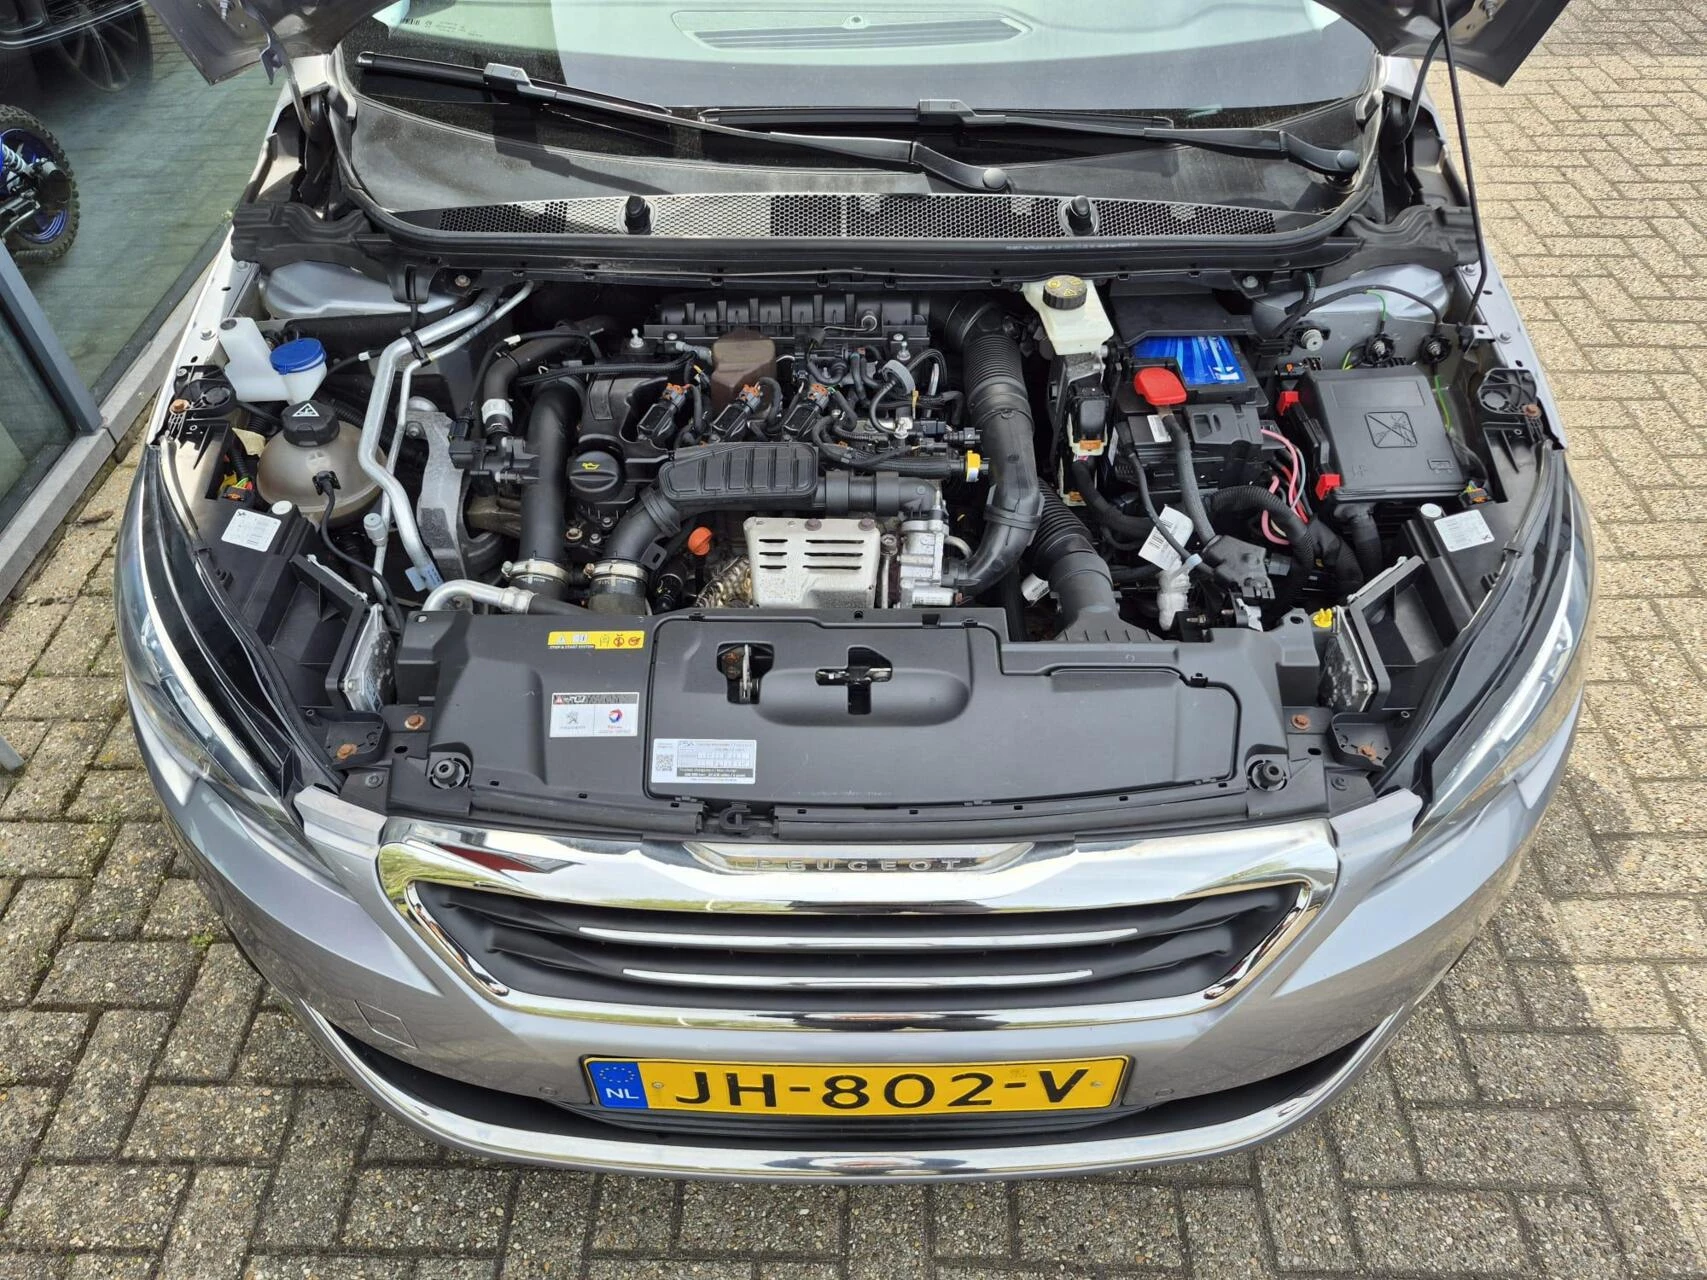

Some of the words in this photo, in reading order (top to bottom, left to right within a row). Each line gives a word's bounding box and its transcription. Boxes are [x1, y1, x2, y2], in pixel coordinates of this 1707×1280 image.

[756, 859, 961, 871] PEUGEOT
[605, 1086, 639, 1099] NL
[676, 1068, 1088, 1109] JH-802-V
